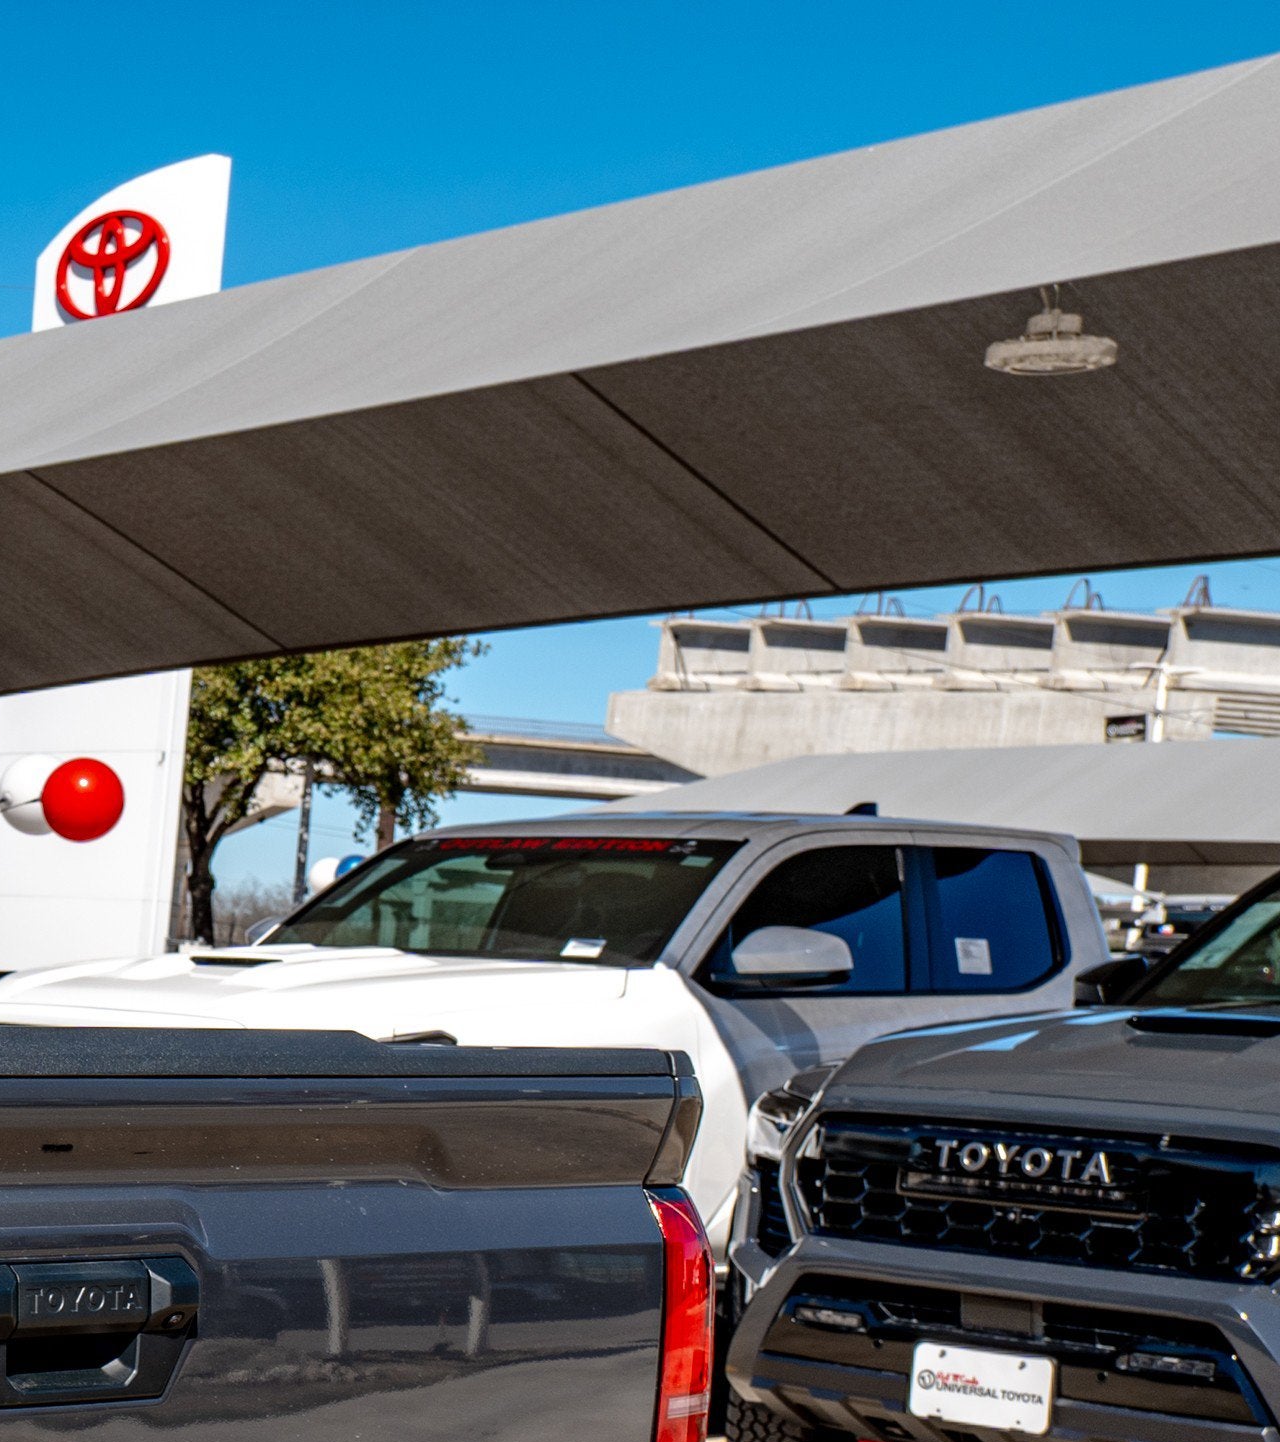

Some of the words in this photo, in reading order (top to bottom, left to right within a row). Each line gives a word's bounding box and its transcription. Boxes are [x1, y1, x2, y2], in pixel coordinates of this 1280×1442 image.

[935, 1139, 1112, 1184] TOYOTA
[26, 1283, 143, 1315] TOYOTA
[935, 1382, 998, 1399] UNIVERSAL
[1000, 1389, 1044, 1405] TOYOTA
